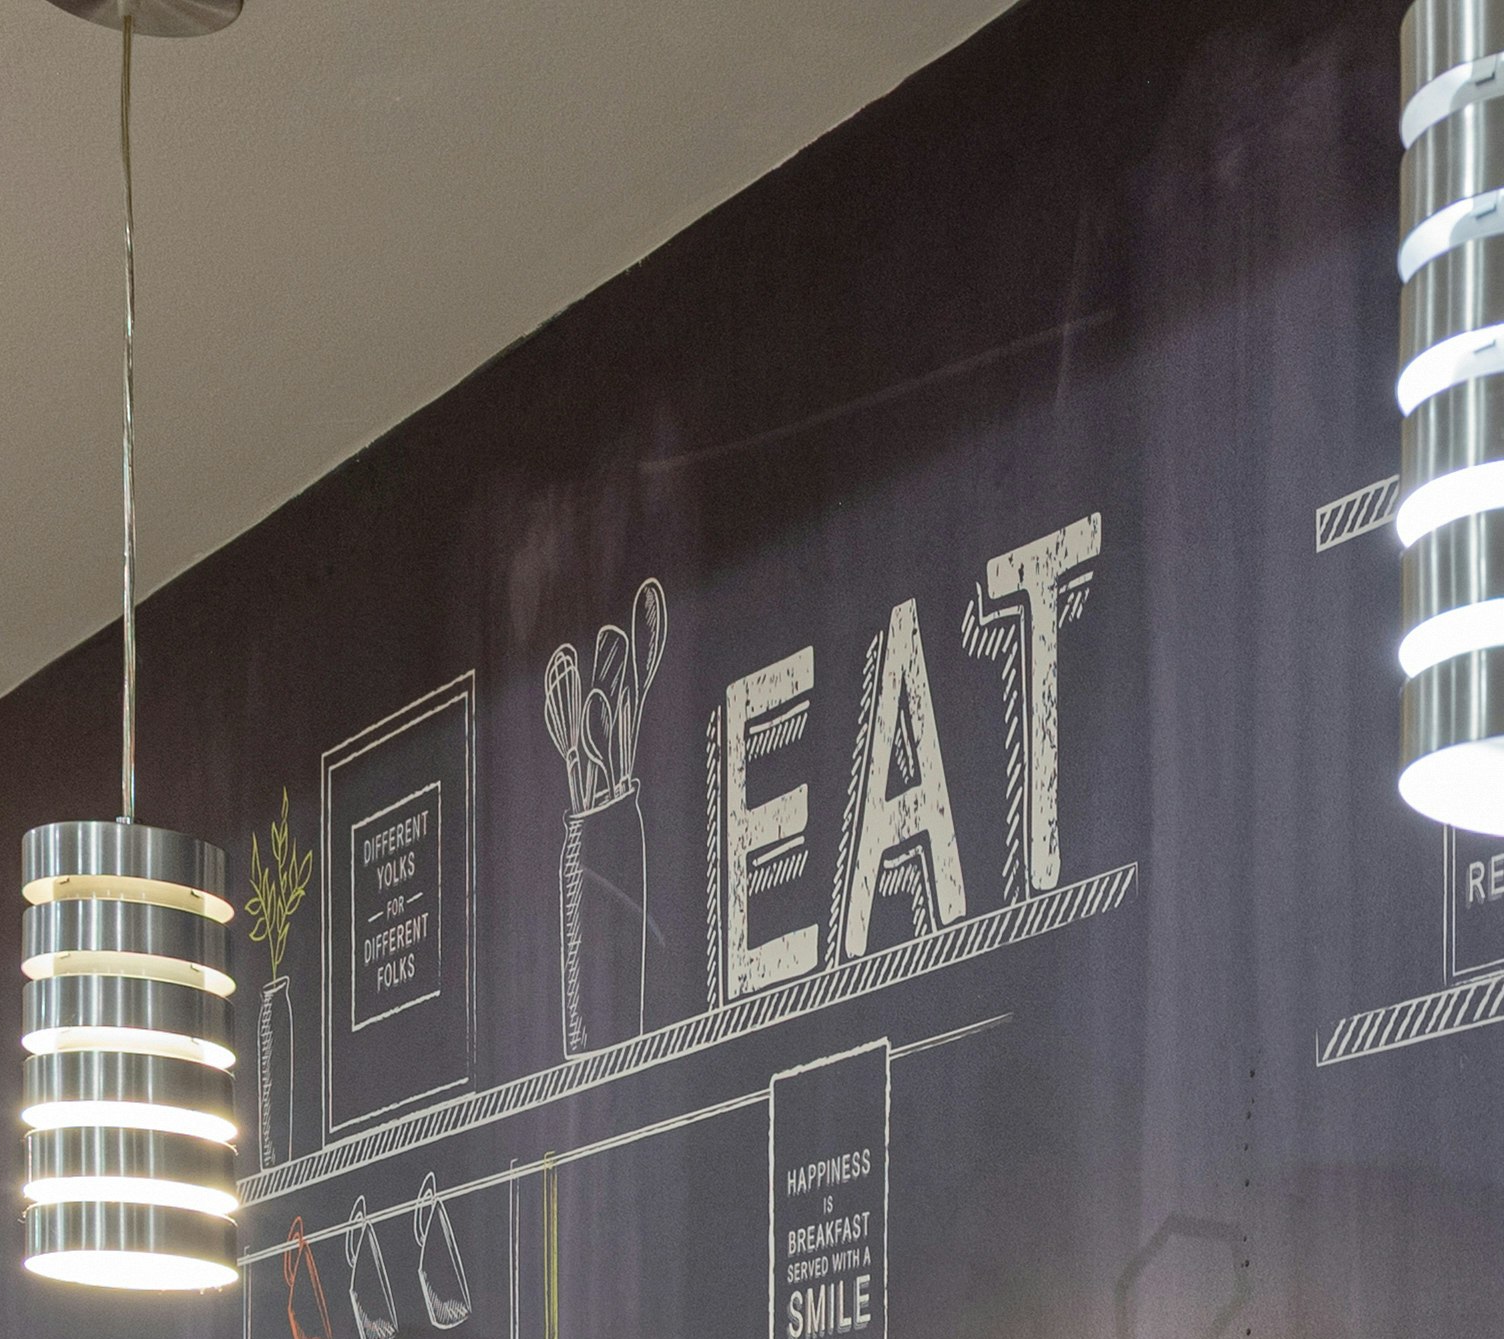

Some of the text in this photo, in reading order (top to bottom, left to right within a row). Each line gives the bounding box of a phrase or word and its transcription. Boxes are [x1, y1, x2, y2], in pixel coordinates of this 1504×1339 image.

[724, 511, 1103, 1001] EAT
[363, 810, 429, 866] DIFFERENT
[377, 851, 416, 890] YOLKS
[386, 895, 405, 919] FOR
[363, 912, 429, 964] DIFFERENT
[377, 953, 416, 992] FOLKS
[787, 1148, 871, 1195] HAPPINESS
[823, 1195, 834, 1214] IS
[788, 1211, 871, 1255] BREAKFAST
[787, 1245, 871, 1283] SERVED WITH A
[787, 1274, 871, 1339] SMILE
